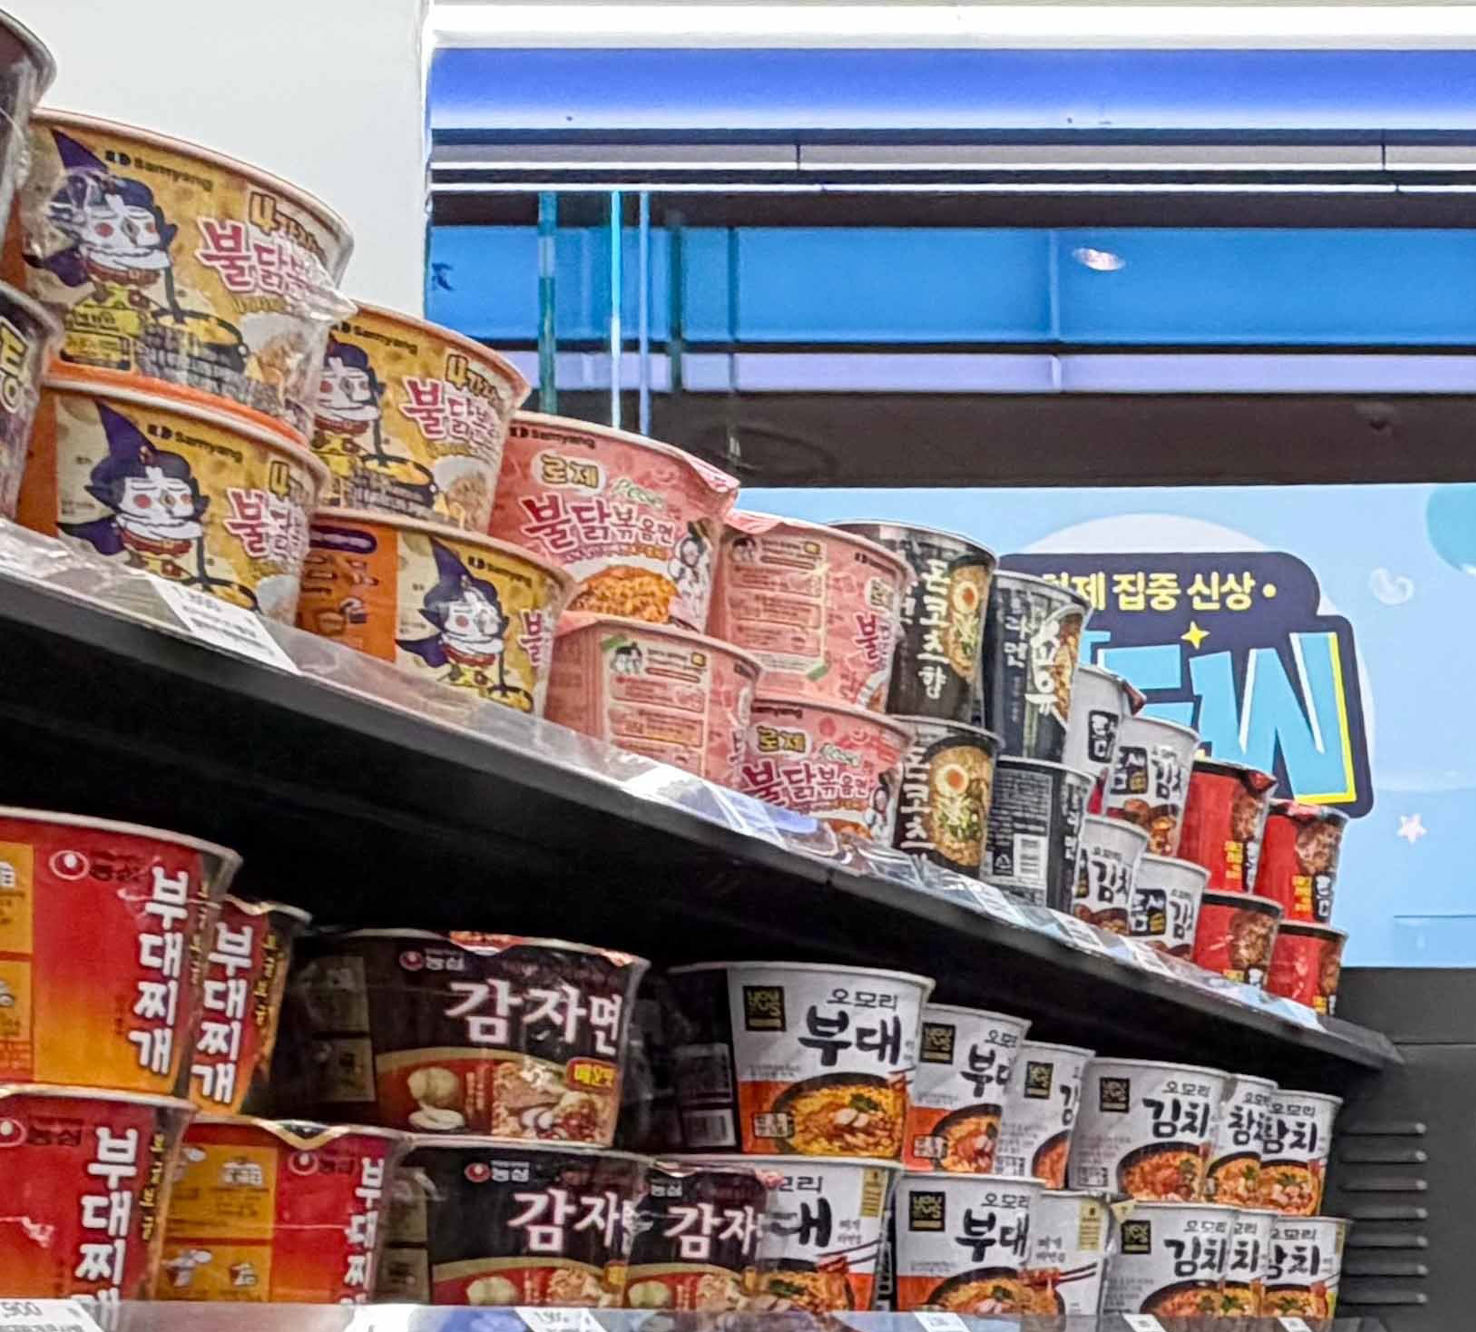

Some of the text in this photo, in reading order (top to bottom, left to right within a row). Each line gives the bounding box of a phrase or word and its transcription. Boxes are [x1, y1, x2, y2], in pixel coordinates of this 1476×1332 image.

[541, 453, 601, 491] 로제
[518, 491, 676, 556] 불닭볶음면
[1112, 572, 1178, 611] 집중
[1188, 570, 1256, 611] 신상
[756, 726, 808, 756] 로제
[128, 864, 190, 1077] 부대찌개
[188, 921, 254, 1106] 부대찌개
[443, 976, 624, 1057] 감자면
[826, 987, 898, 1012] 오모리
[797, 1004, 902, 1067] 부대
[1161, 1079, 1212, 1099] 오모리
[1142, 1097, 1211, 1139] 김치
[981, 1191, 1032, 1210] 오모리
[340, 1156, 386, 1305] 부대찌
[667, 1203, 762, 1260] 감자
[954, 1207, 1031, 1264] 부대
[1183, 1219, 1228, 1235] 오모리
[1162, 1237, 1228, 1278] 김치
